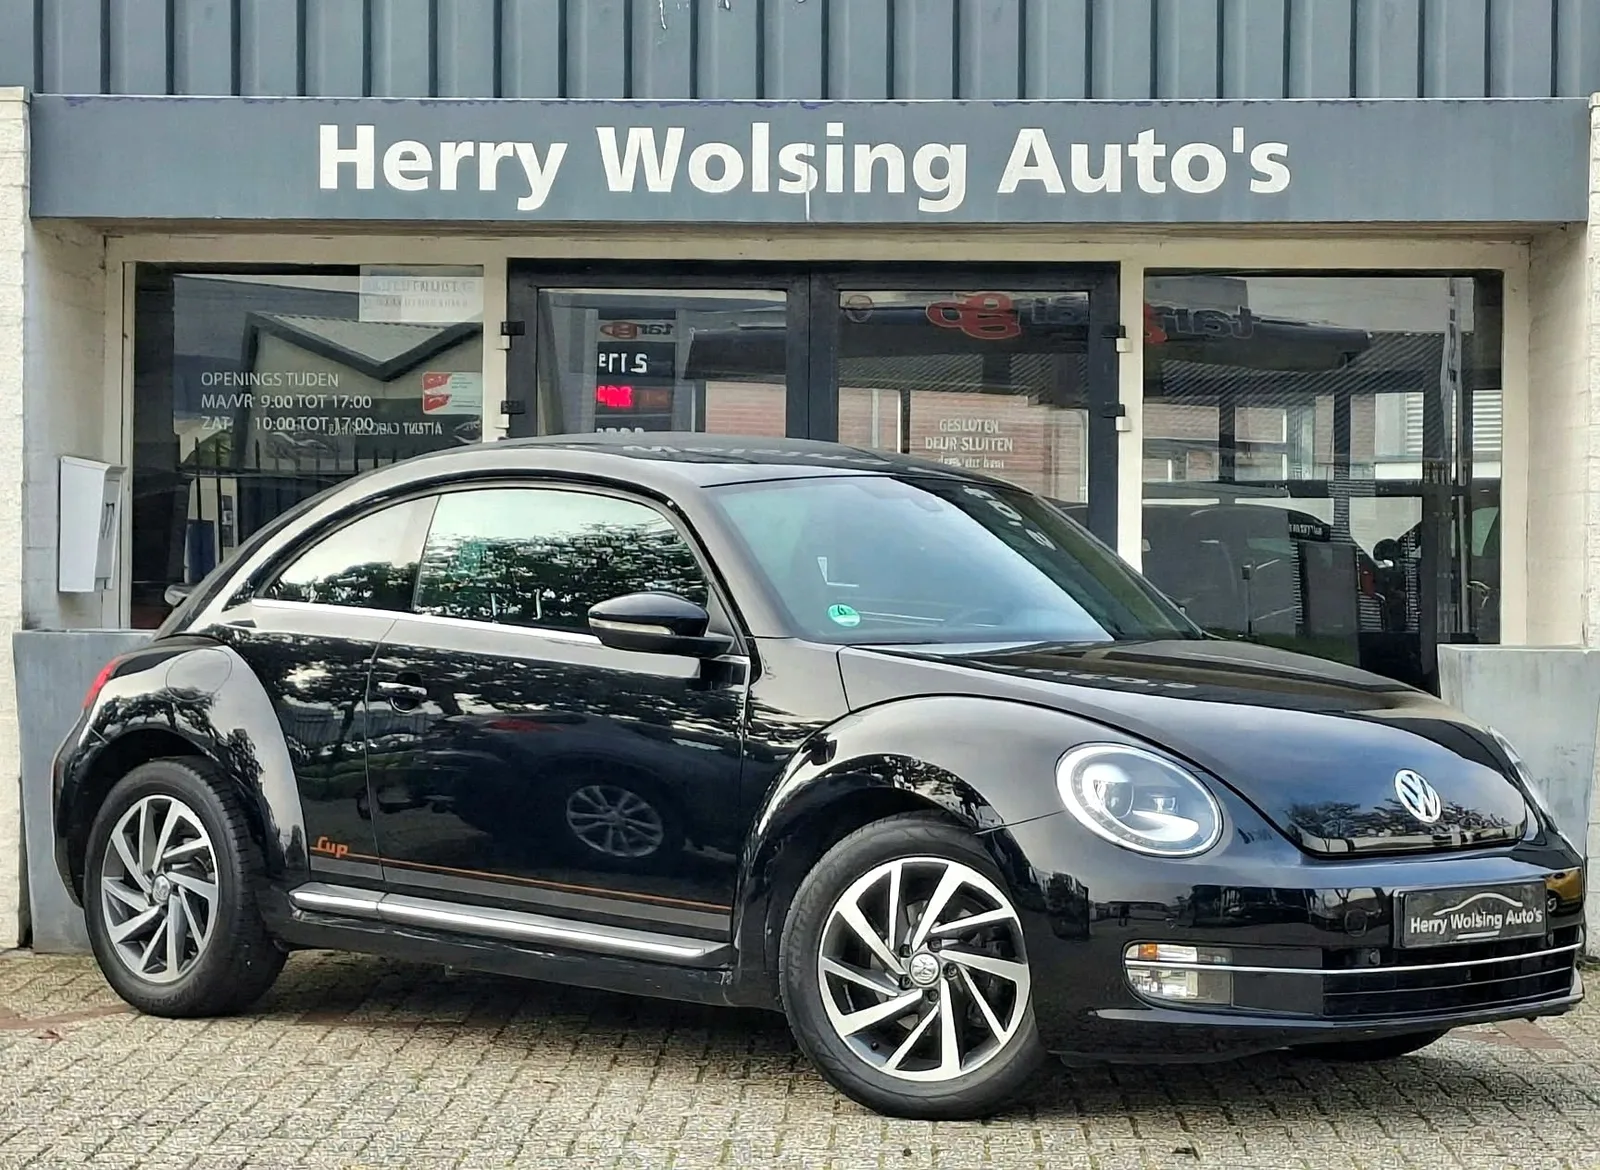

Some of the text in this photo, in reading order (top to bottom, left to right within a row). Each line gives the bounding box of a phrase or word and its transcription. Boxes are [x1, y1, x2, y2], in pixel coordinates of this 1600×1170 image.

[319, 122, 1291, 212] Herry Wolsing Auto's
[201, 372, 282, 386] OPENINGS
[201, 393, 372, 409] MA/VR 9:00 TOT 17:00
[255, 416, 296, 430] 10:00
[298, 416, 329, 431] TOT
[925, 436, 1013, 452] DEUR SLUITEN
[317, 836, 348, 858] Cup
[1410, 907, 1543, 934] Herry Wolsing Auto's
